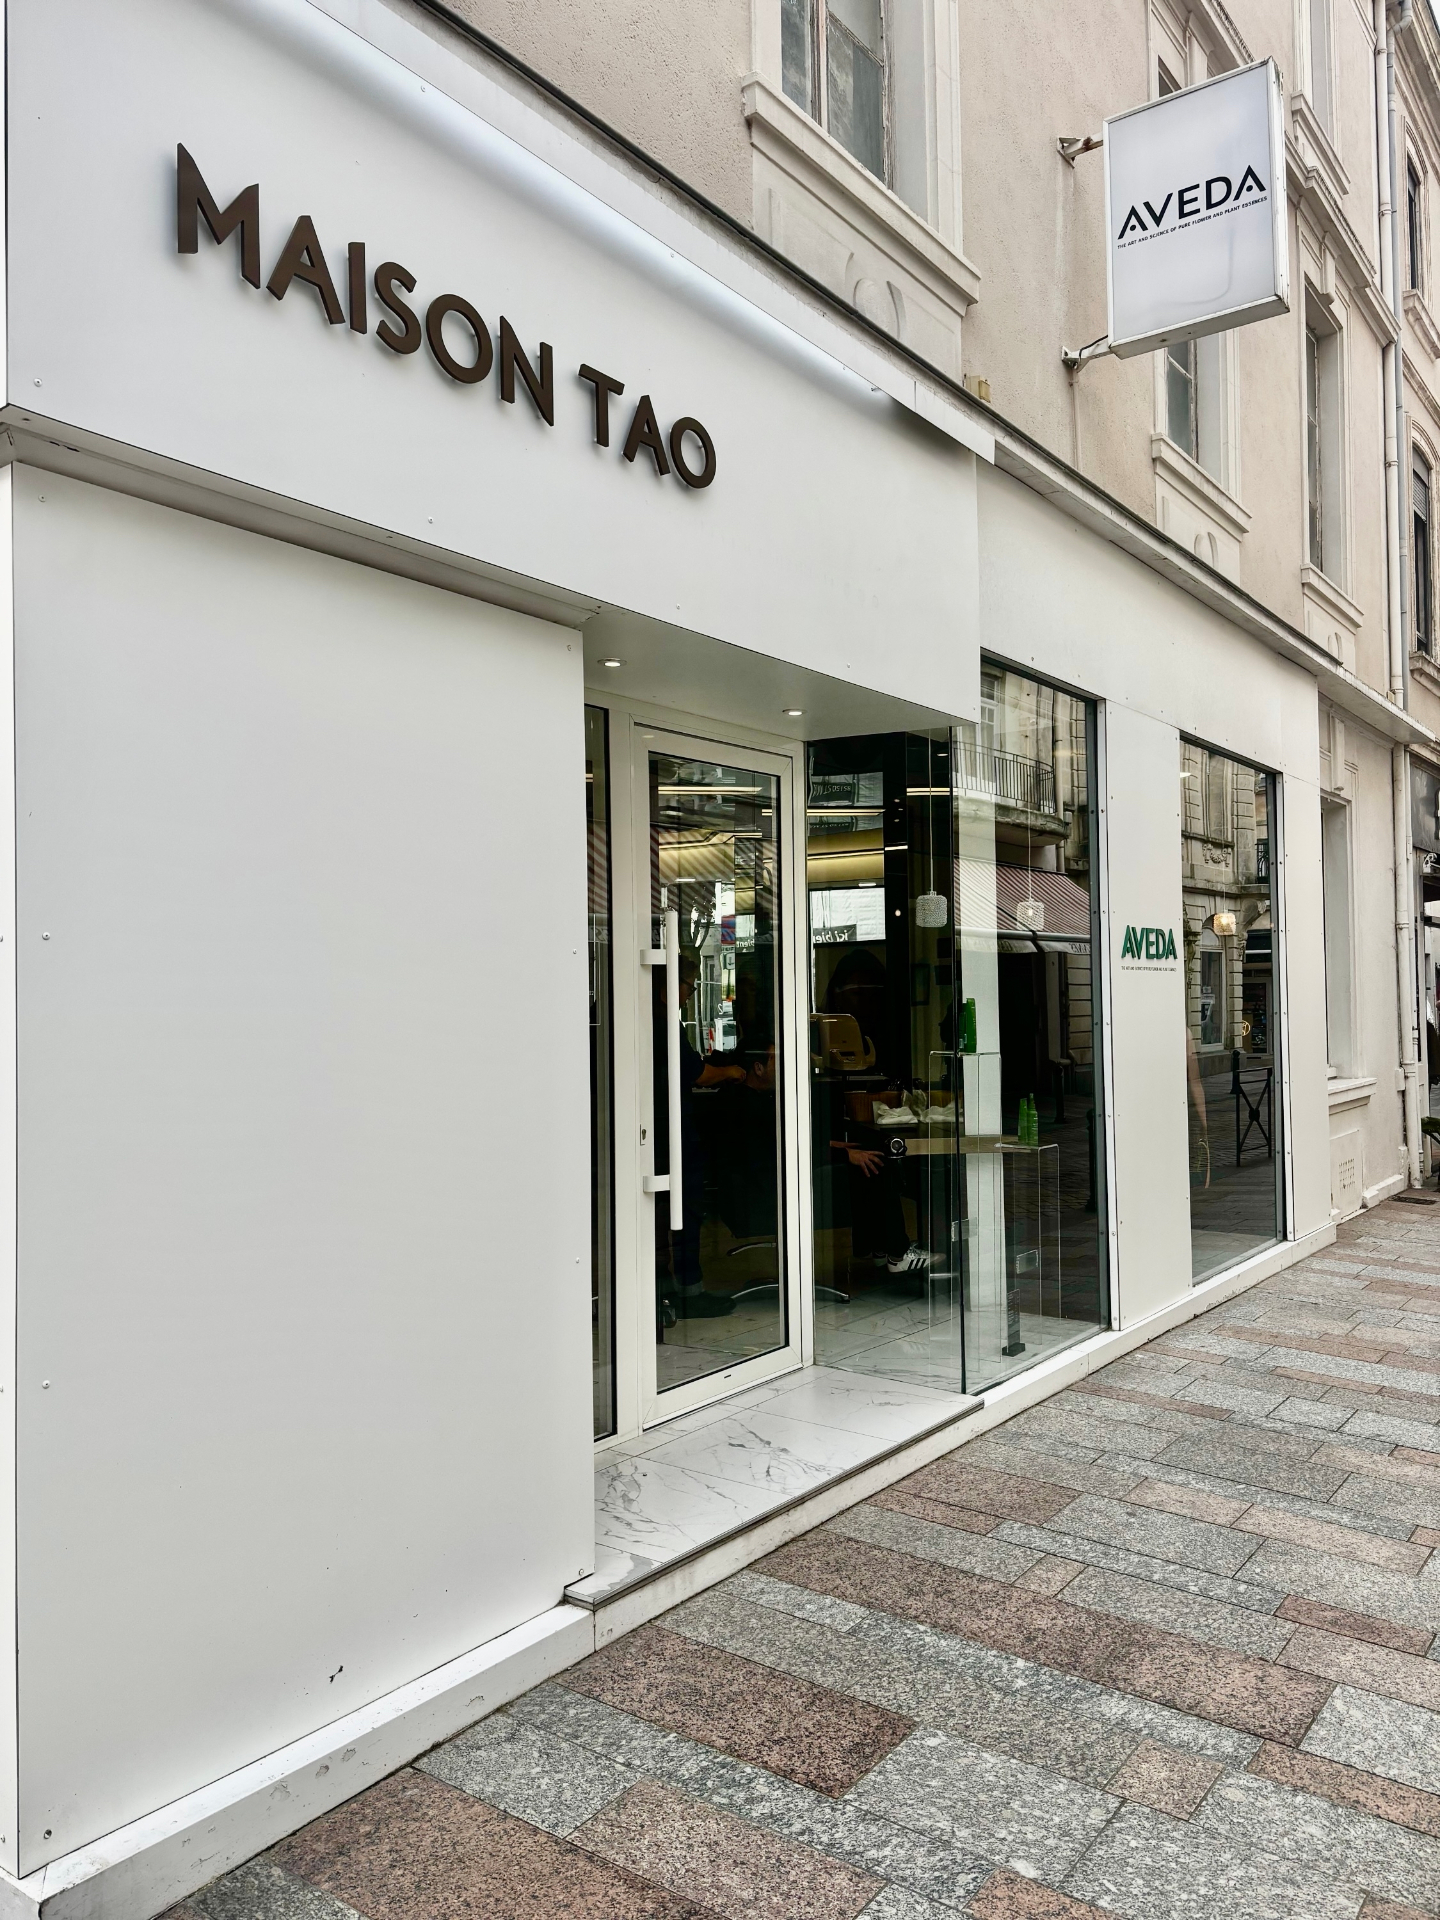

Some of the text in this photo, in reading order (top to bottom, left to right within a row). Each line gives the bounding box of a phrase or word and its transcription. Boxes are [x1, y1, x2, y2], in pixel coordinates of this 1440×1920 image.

[1117, 164, 1267, 240] AVEDA
[1127, 239, 1137, 247] ART
[1149, 228, 1169, 239] SCIENCE
[1178, 221, 1191, 230] PURE
[1191, 215, 1212, 225] FLOWER
[1224, 205, 1241, 214] PLANT
[1241, 195, 1268, 208] ESSENCES
[176, 142, 717, 489] MAISON TAO
[1121, 924, 1178, 960] AVEDA
